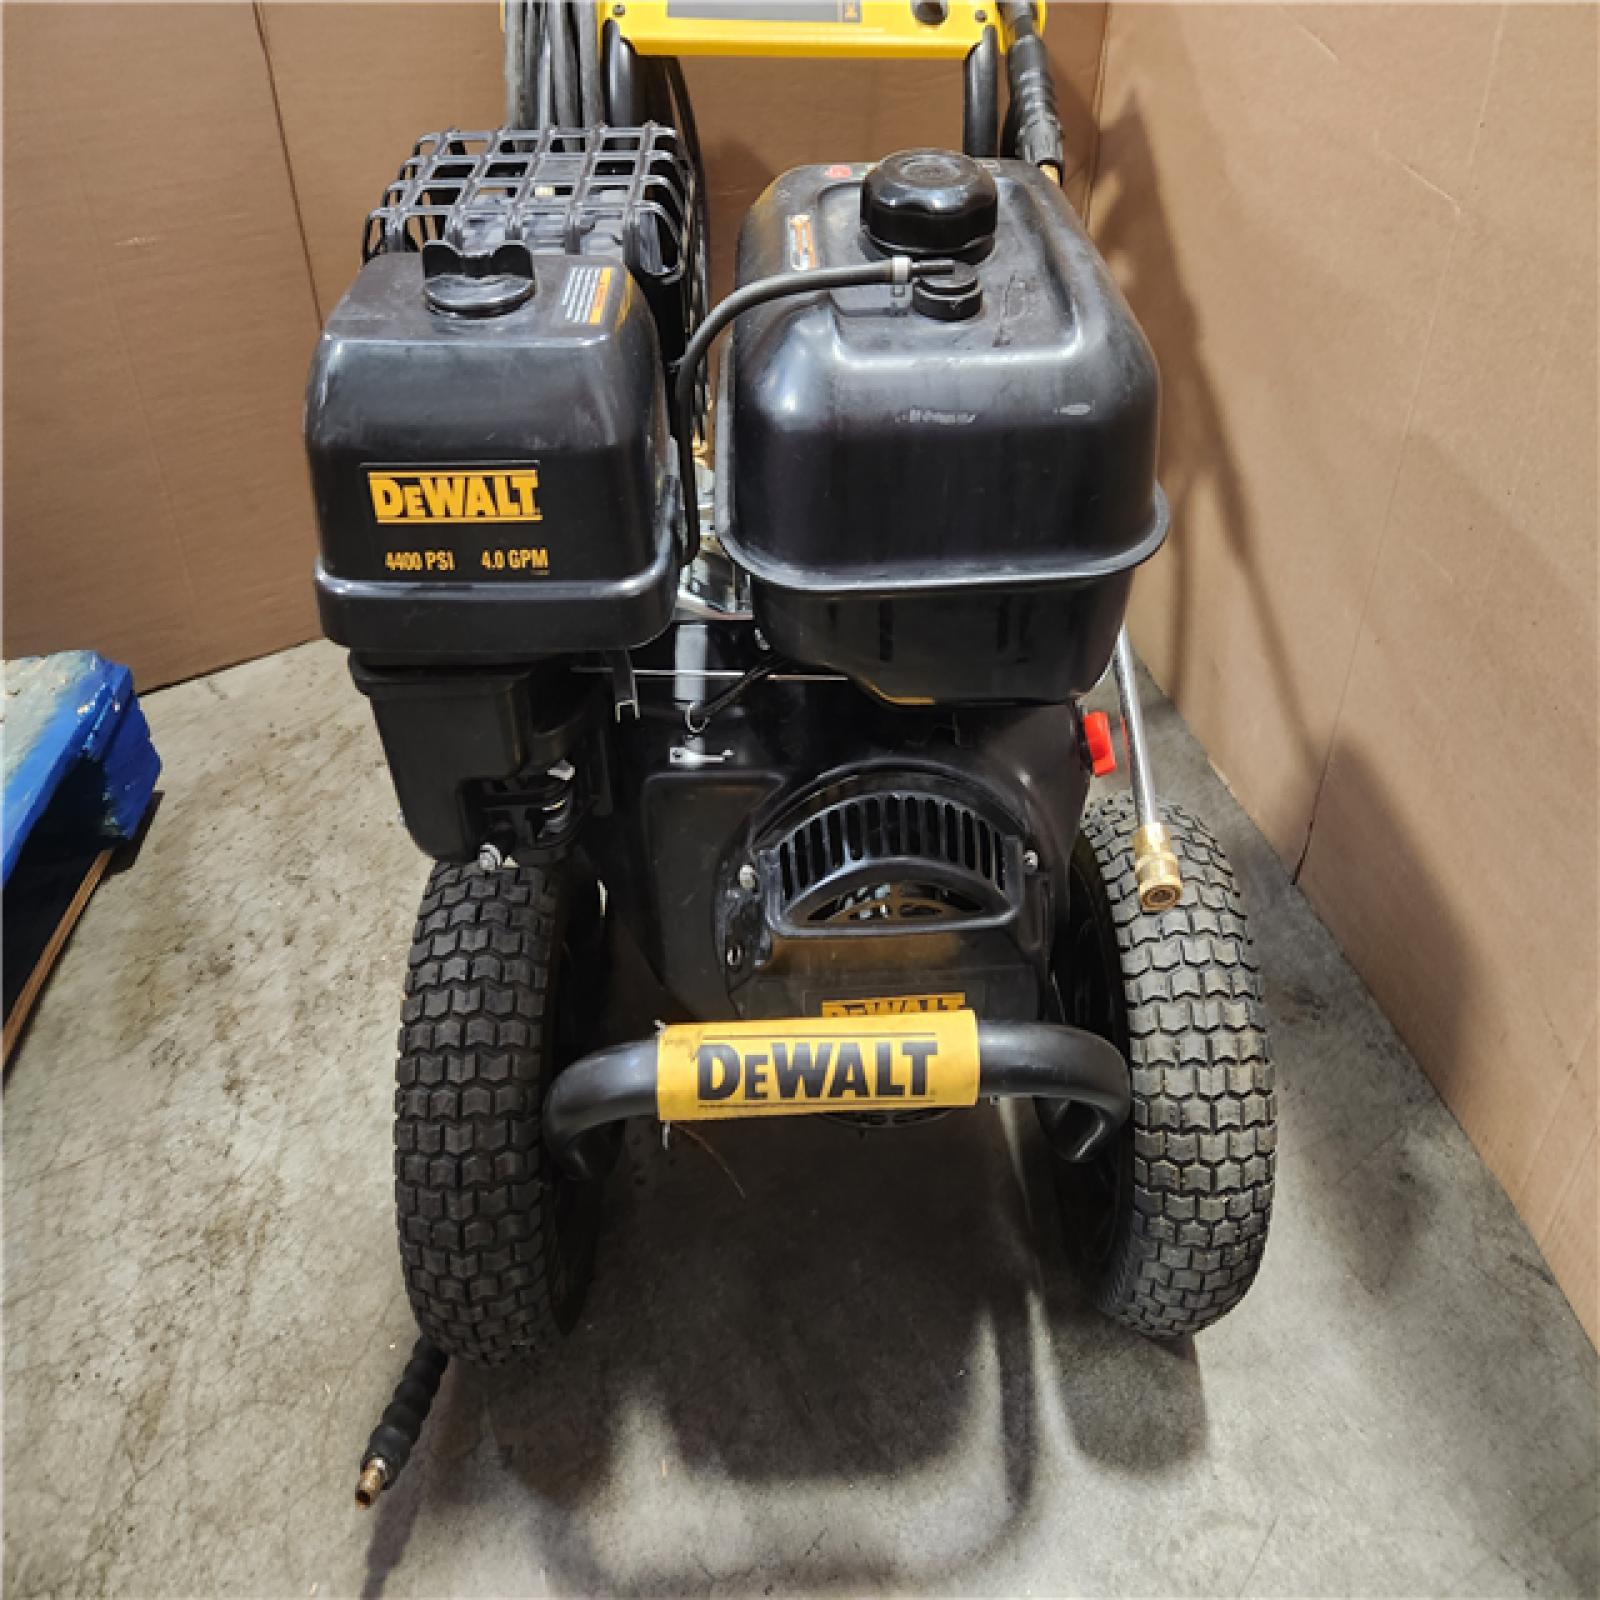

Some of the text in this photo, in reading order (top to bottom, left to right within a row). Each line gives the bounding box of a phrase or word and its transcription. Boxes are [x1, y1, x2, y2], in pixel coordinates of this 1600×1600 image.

[425, 550, 455, 571] PSI
[481, 549, 505, 570] 4.0
[507, 547, 549, 570] GPM
